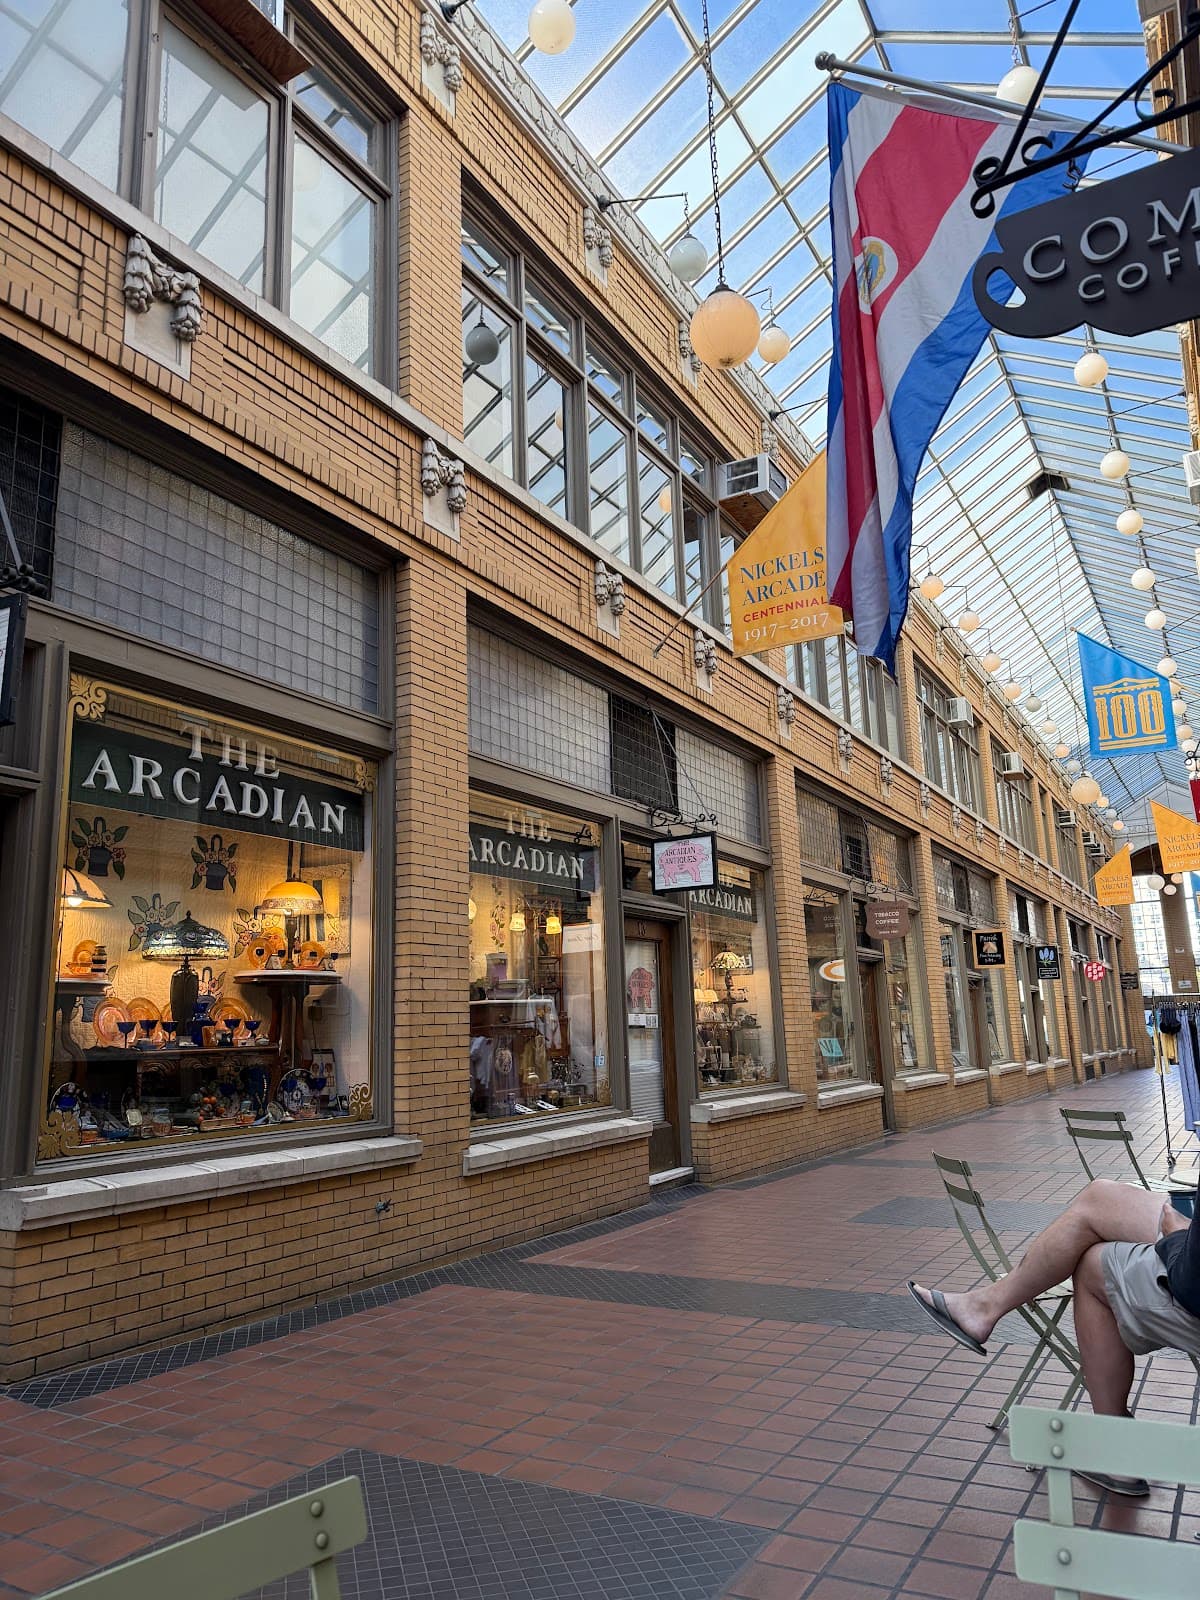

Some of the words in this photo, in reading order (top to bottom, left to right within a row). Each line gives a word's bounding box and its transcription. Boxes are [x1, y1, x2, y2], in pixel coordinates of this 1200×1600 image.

[1077, 240, 1200, 300] COF
[740, 546, 825, 584] NICKELS
[742, 569, 826, 607] ARCADE
[743, 595, 829, 623] CENTENNIAL
[1094, 690, 1165, 740] 100
[179, 721, 280, 780] THE
[81, 748, 347, 835] ARCADIAN
[503, 810, 552, 843] THE
[664, 846, 696, 857] ARCADIAN
[664, 855, 697, 865] ANTIQUES
